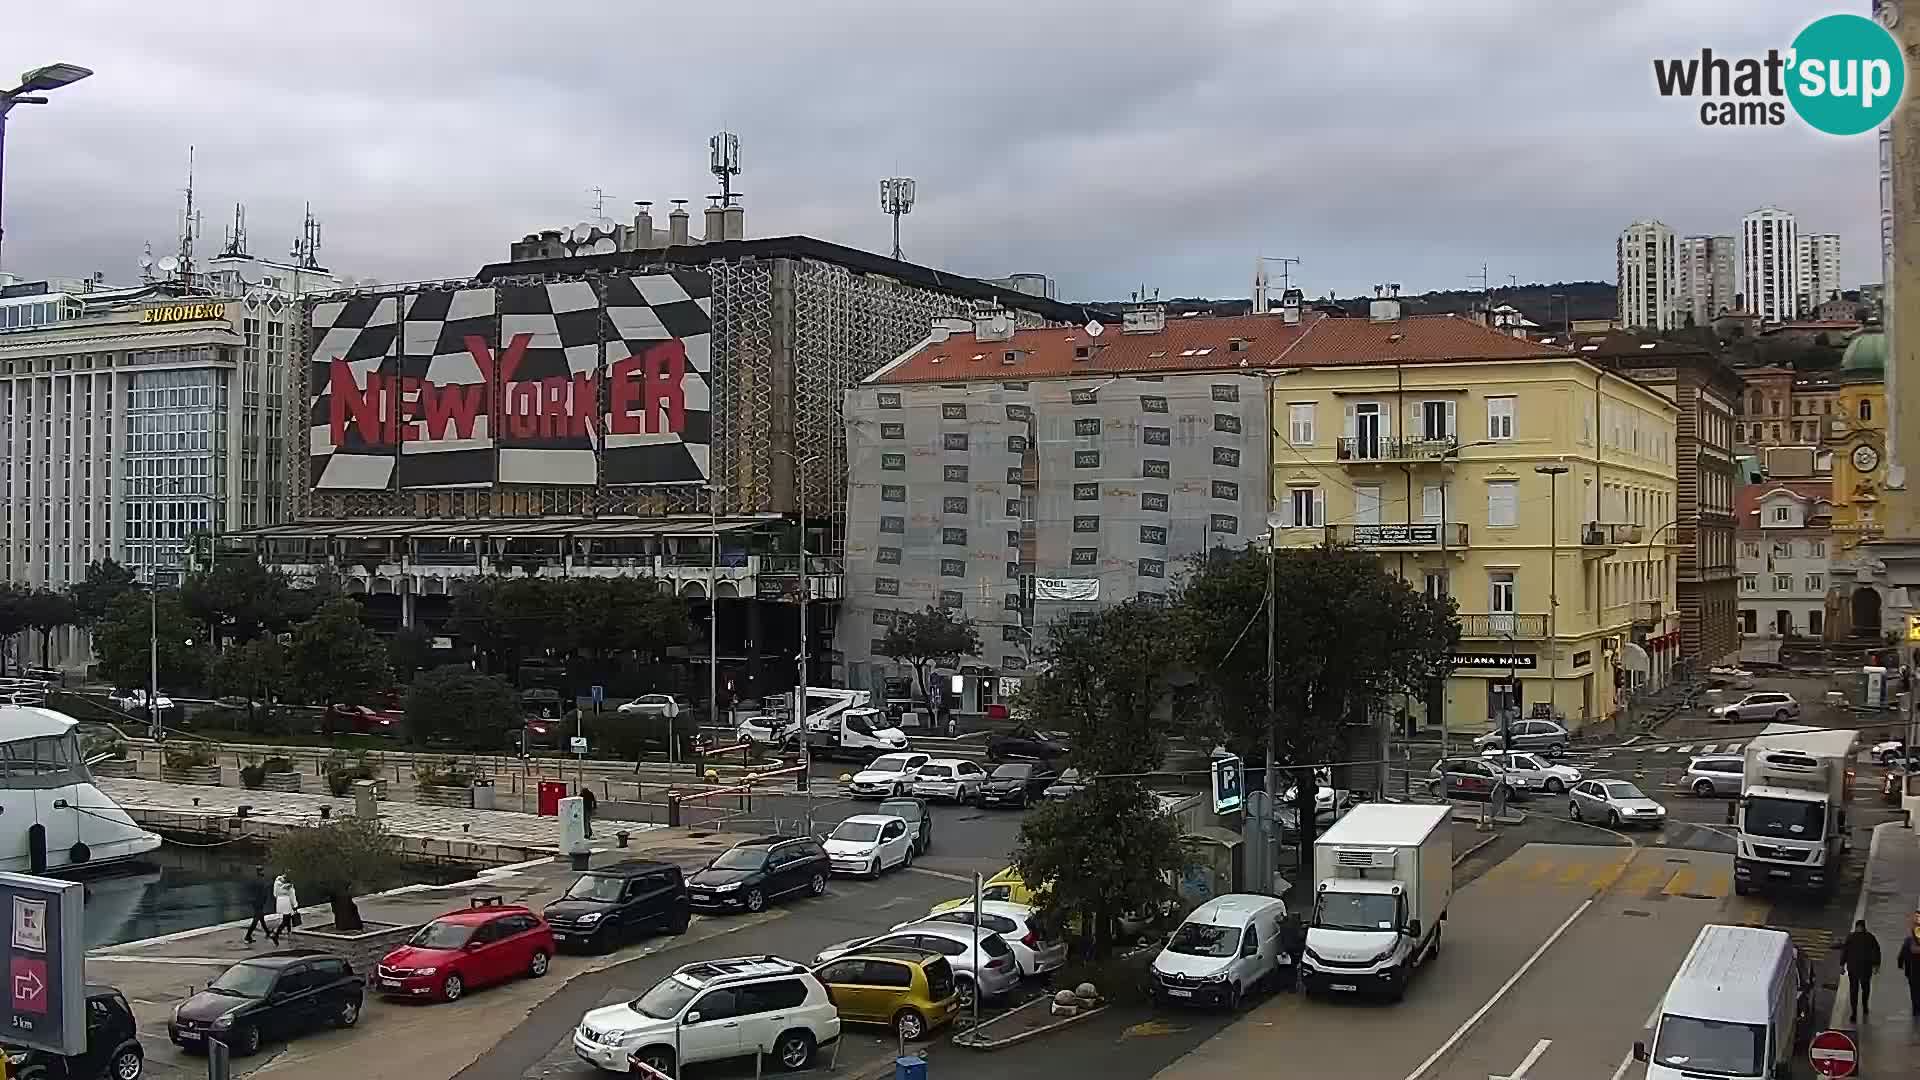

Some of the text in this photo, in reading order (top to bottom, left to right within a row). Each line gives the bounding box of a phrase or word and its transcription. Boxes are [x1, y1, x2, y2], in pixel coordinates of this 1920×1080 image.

[1451, 656, 1531, 665] JULIANA NAILS
[19, 1017, 33, 1030] km
